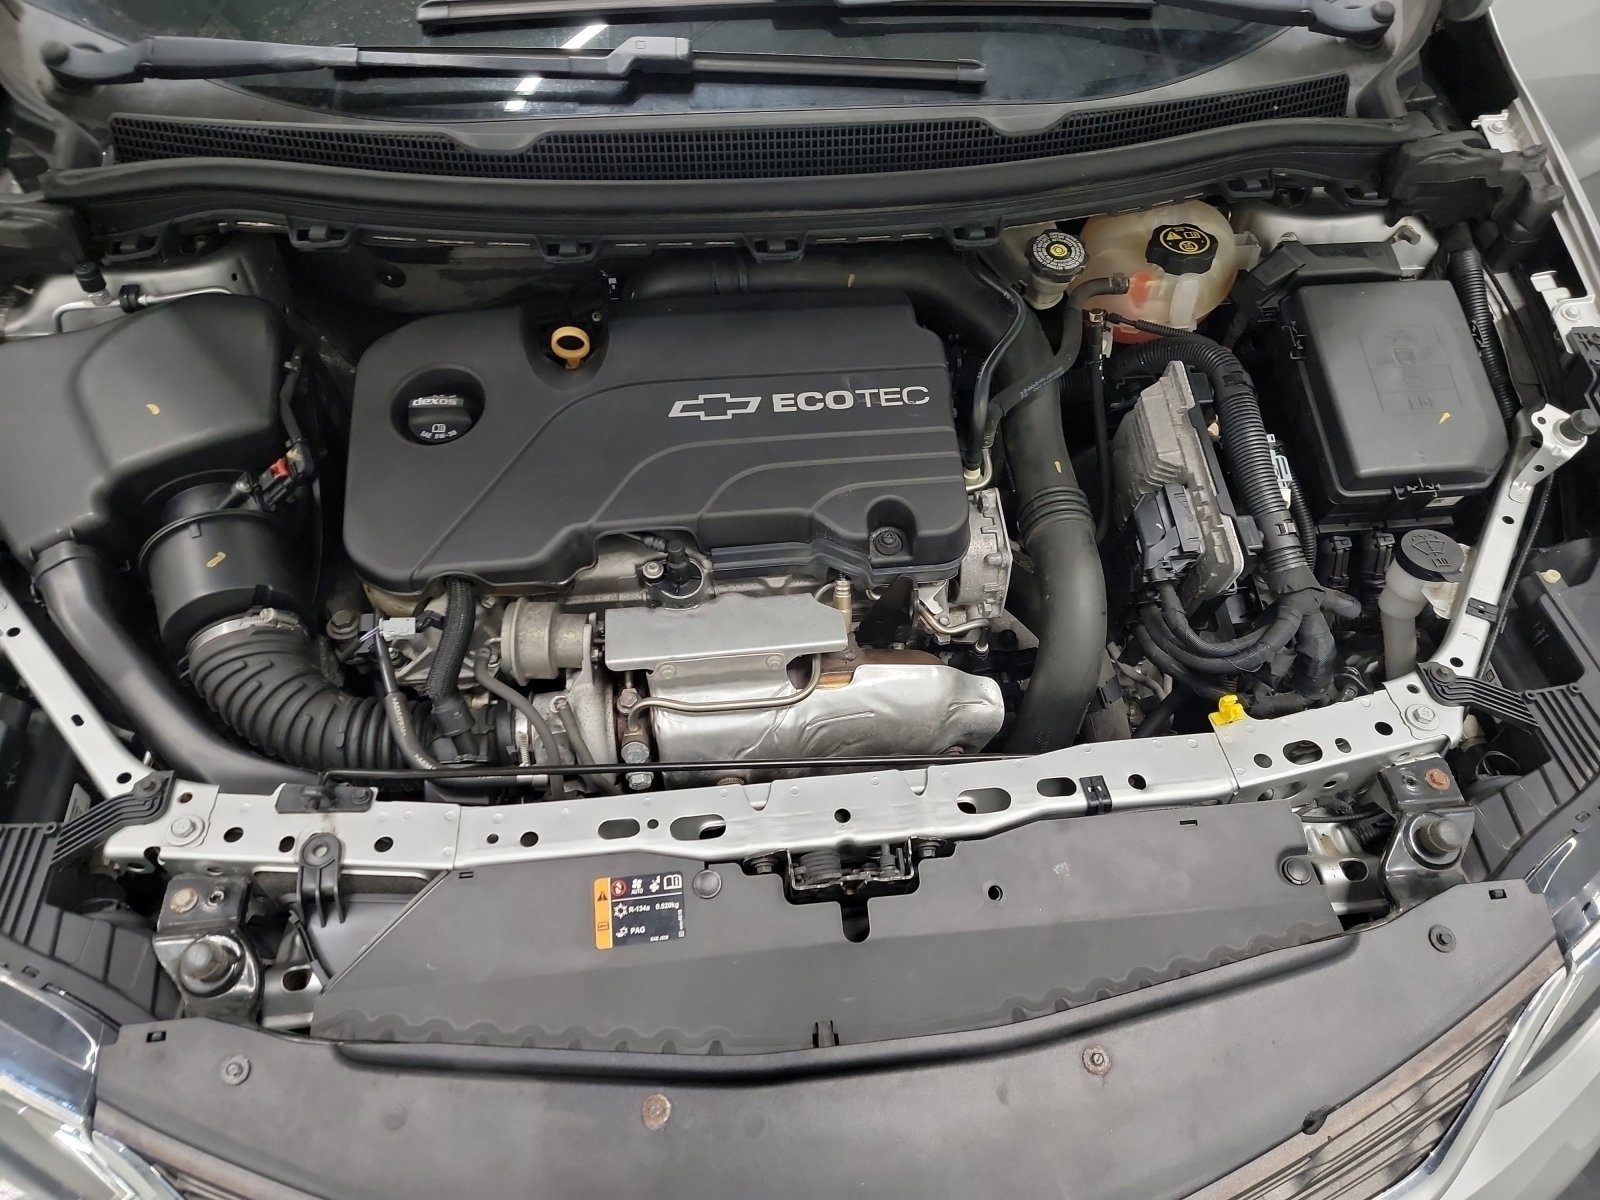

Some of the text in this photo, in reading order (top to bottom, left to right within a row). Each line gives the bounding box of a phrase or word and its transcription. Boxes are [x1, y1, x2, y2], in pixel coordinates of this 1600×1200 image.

[412, 397, 457, 406] dexos
[772, 386, 930, 412] ECOTEC
[628, 905, 651, 913] R-134a
[630, 926, 646, 935] PAG
